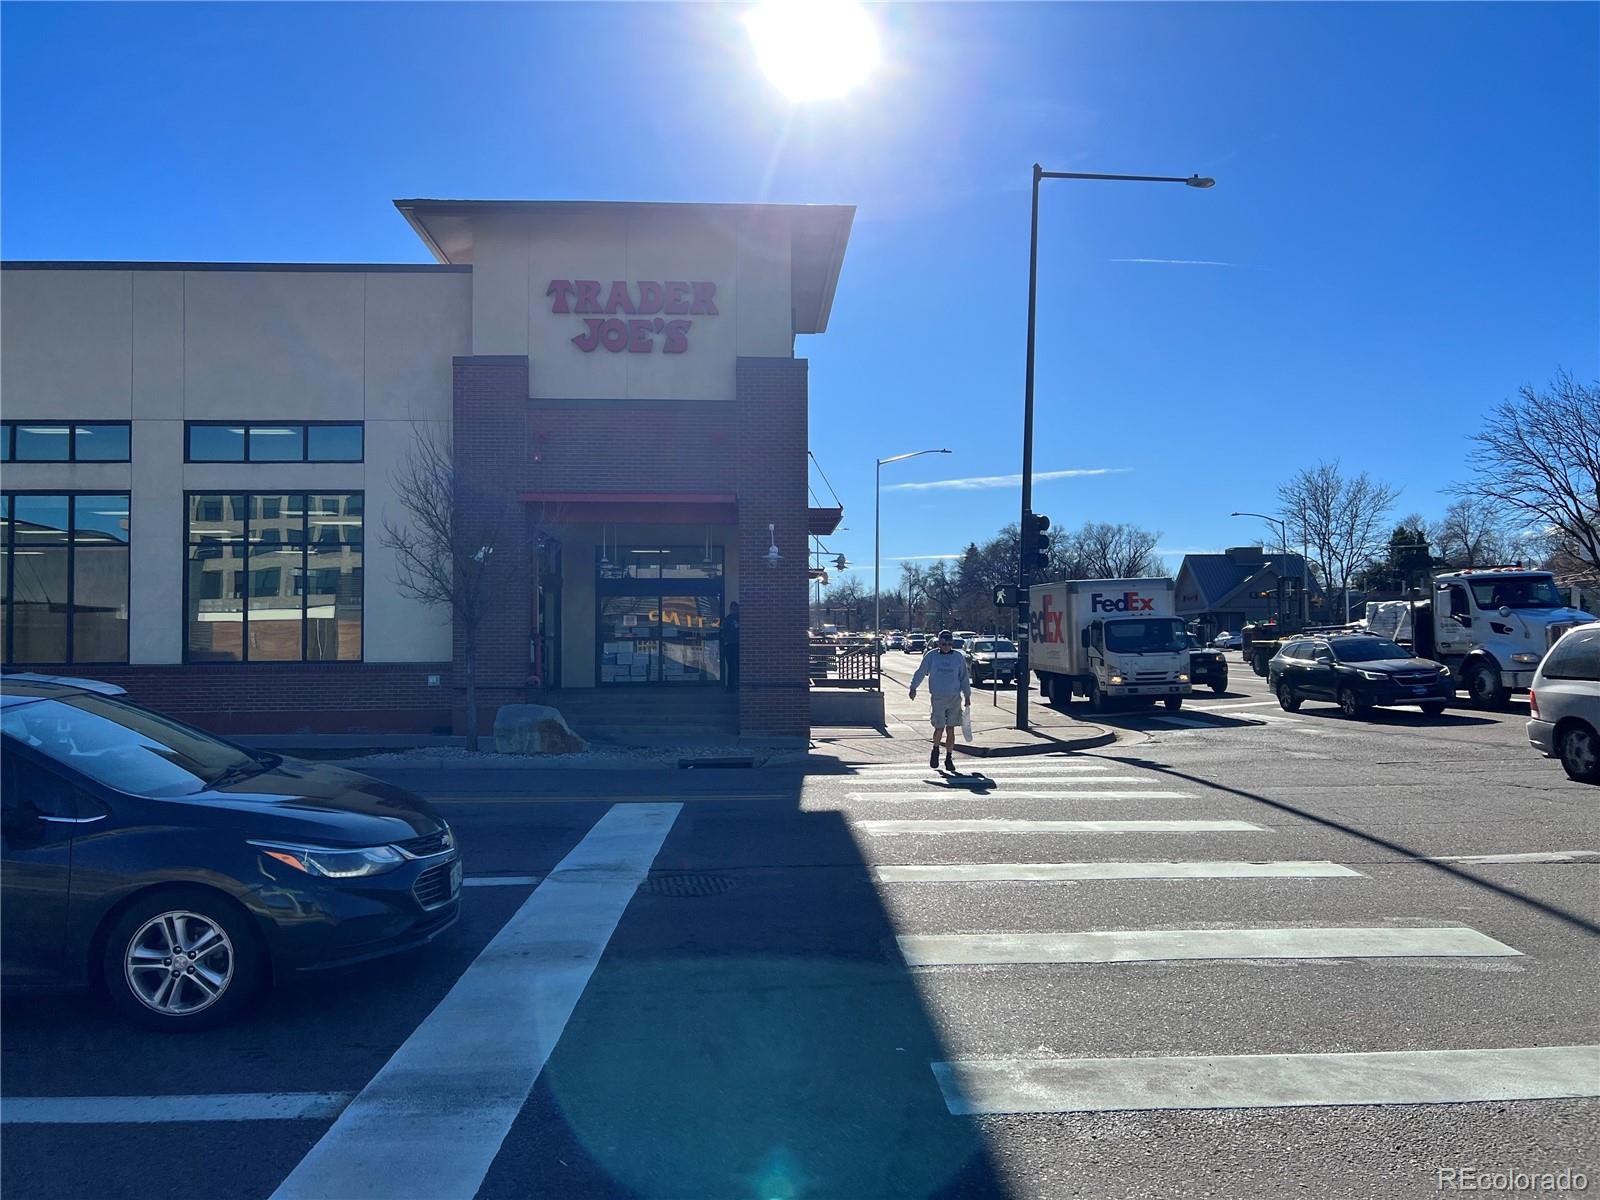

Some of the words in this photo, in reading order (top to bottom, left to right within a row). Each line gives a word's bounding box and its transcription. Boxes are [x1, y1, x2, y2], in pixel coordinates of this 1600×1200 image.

[546, 280, 719, 316] TRADER
[571, 317, 692, 354] JOE'S
[1030, 594, 1064, 644] edEx
[1091, 592, 1154, 613] FedEx
